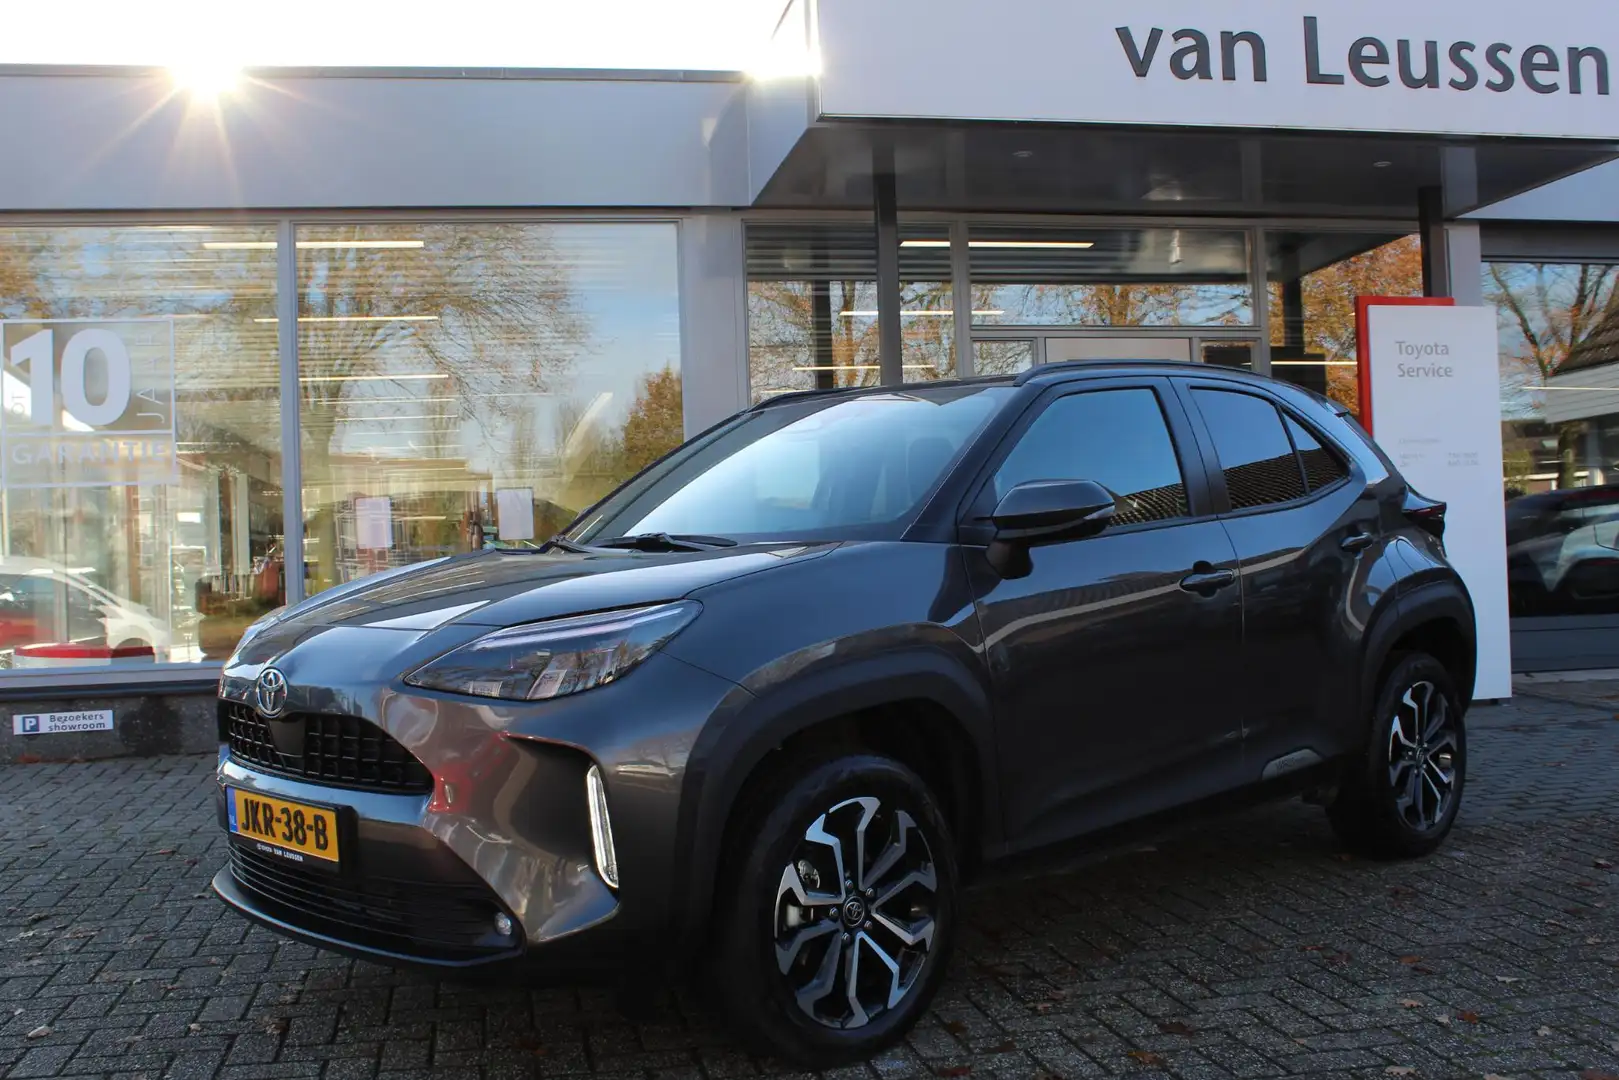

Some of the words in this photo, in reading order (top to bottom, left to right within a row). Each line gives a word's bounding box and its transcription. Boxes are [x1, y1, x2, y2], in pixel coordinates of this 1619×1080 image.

[1115, 26, 1268, 82] van
[1303, 16, 1610, 95] Leussen
[1395, 341, 1450, 360] Toyota
[9, 328, 131, 426] 10
[1397, 363, 1454, 378] Service
[12, 440, 167, 465] GARANTIE
[25, 718, 37, 731] P
[48, 721, 105, 732] showroom
[49, 713, 104, 723] Bezoekers
[241, 798, 329, 851] JKR-38-B
